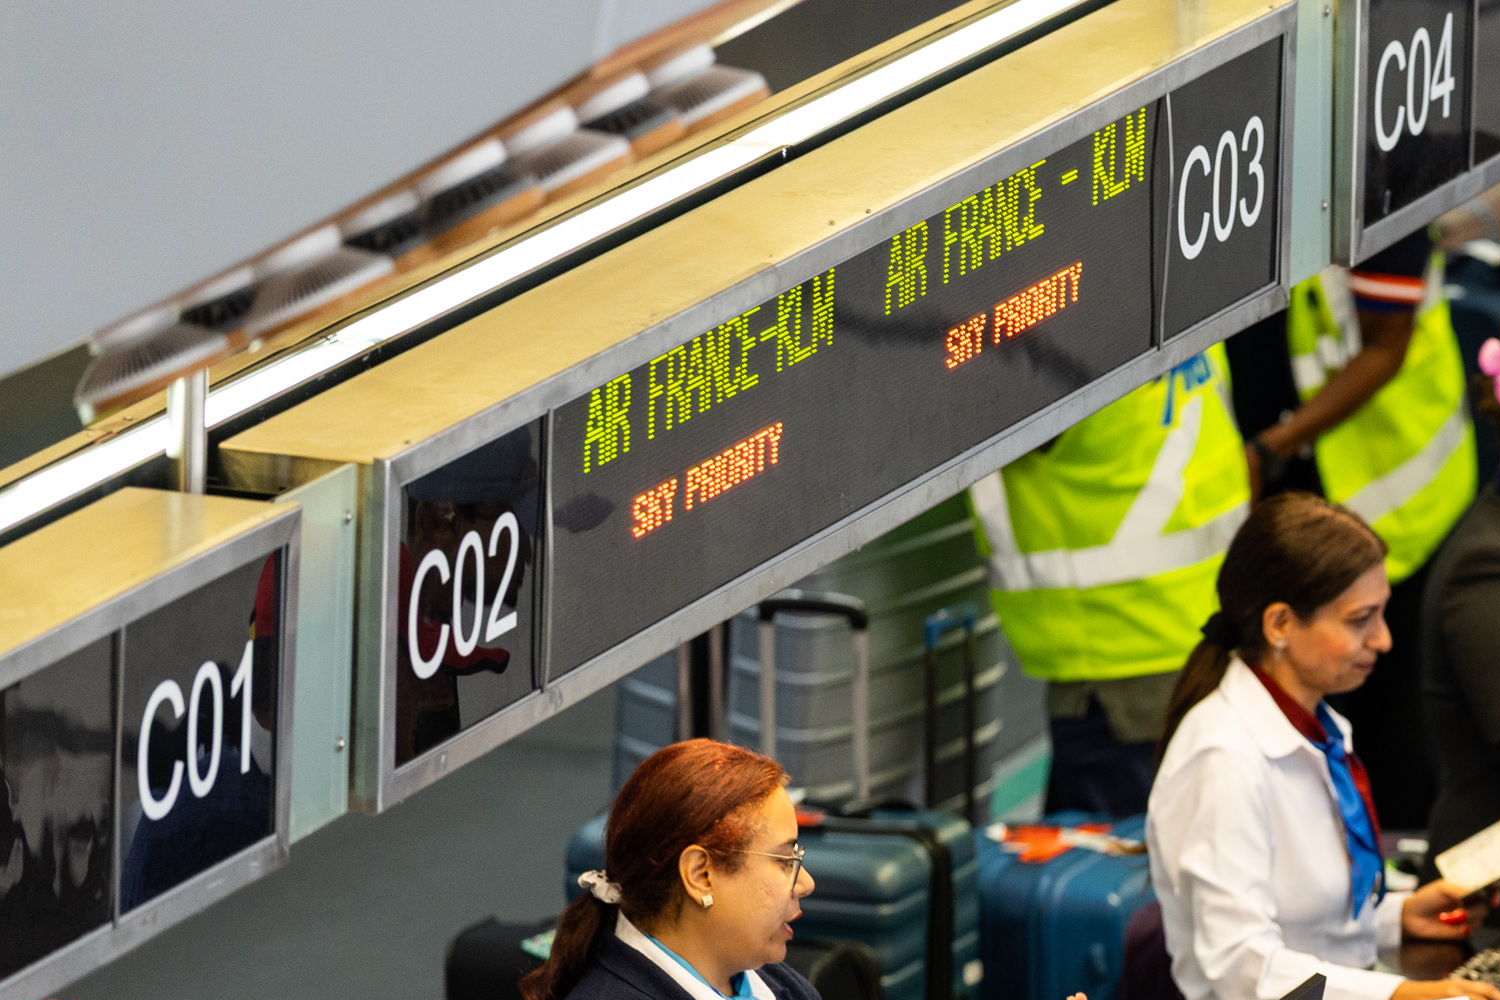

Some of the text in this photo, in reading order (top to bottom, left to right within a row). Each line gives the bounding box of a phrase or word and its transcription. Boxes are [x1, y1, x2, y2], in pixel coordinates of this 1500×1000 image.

[1375, 12, 1455, 151] C04
[885, 220, 929, 315] AIR
[943, 159, 1046, 284] FRANCE
[1093, 107, 1146, 206] KLM
[1178, 115, 1264, 260] C03
[583, 267, 835, 474] AIR FRANCE-KLM
[946, 262, 1082, 369] SKY PRIORITY
[632, 422, 783, 538] SKY PRIORITY
[408, 511, 519, 679] C02
[137, 639, 254, 821] C01
